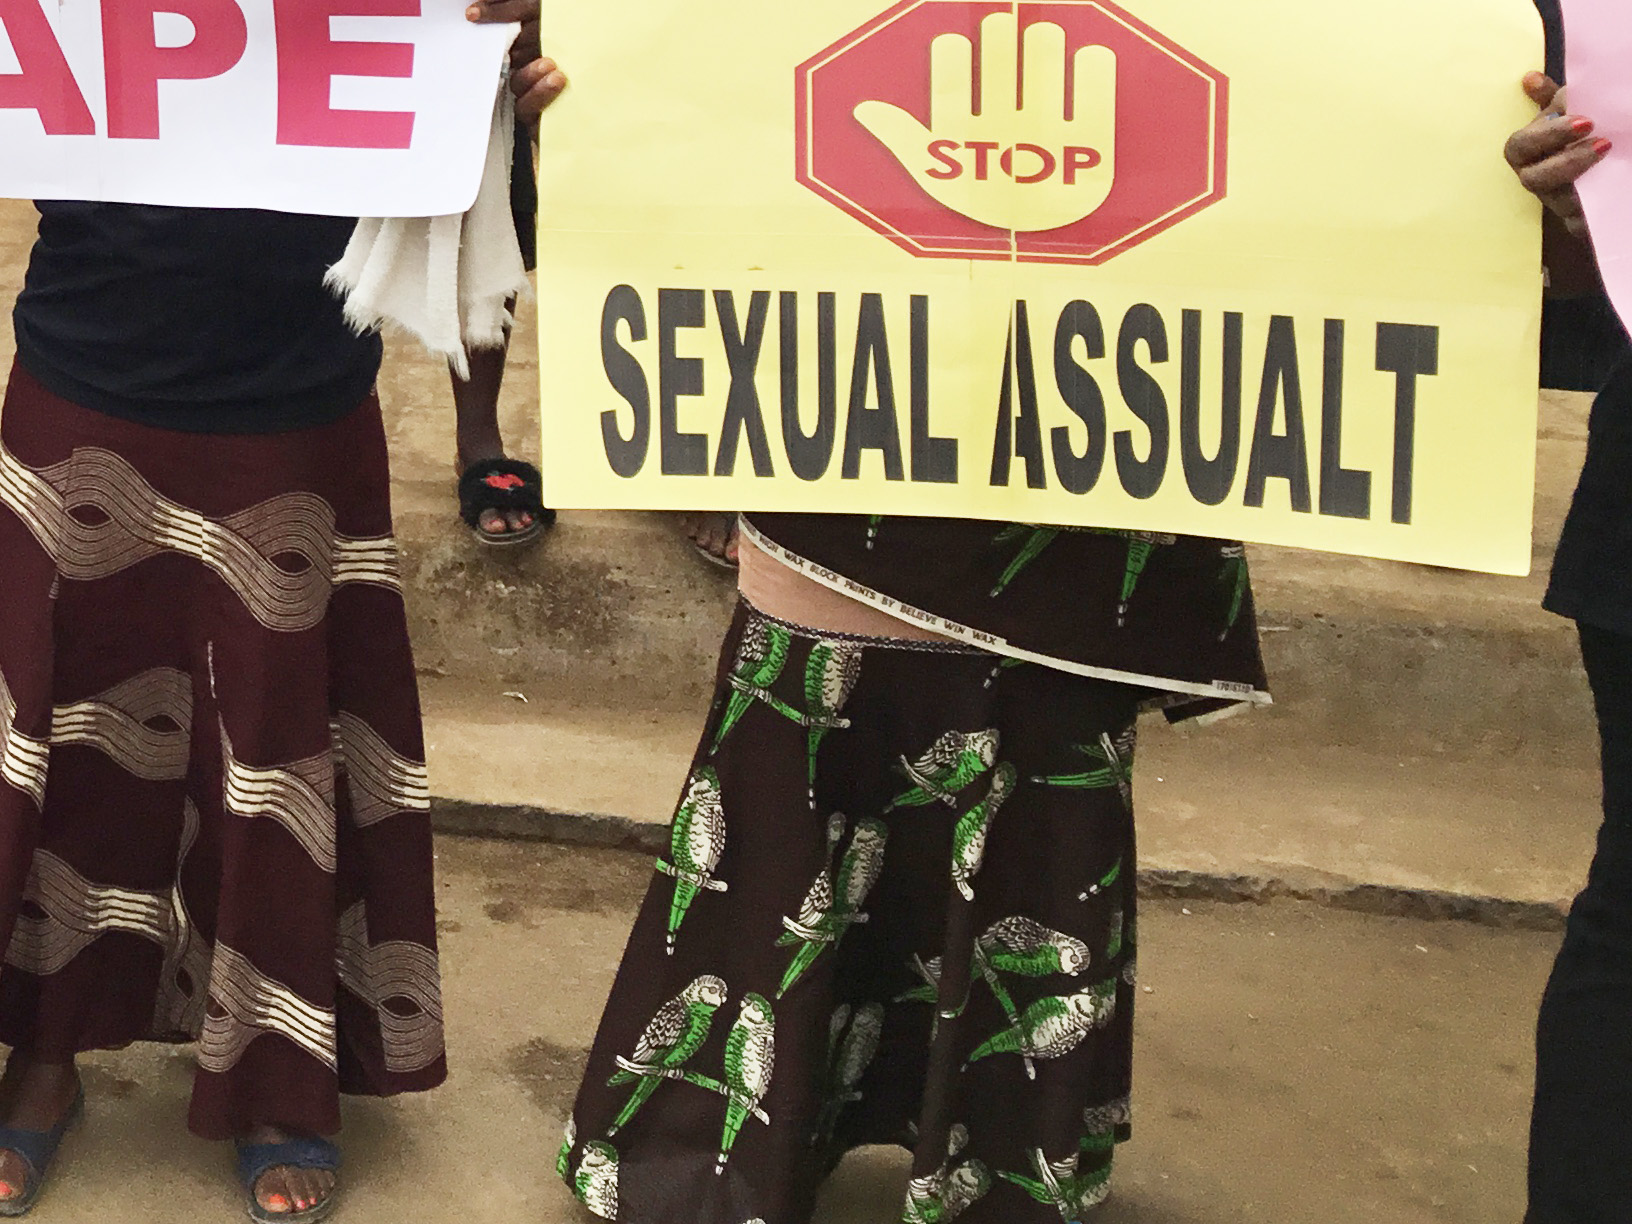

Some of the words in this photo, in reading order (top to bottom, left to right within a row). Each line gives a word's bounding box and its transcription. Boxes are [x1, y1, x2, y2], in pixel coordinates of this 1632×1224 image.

[924, 138, 1103, 186] STOP
[599, 284, 960, 485] SEXUAL
[988, 298, 1440, 526] ASSUALT
[783, 550, 805, 568] WAX
[809, 564, 840, 584] BLOCK
[843, 580, 876, 601] PRINTS
[881, 596, 896, 608] BY
[899, 604, 938, 626] BELIEVE
[943, 619, 967, 635] WIN
[972, 630, 997, 646] WAX
